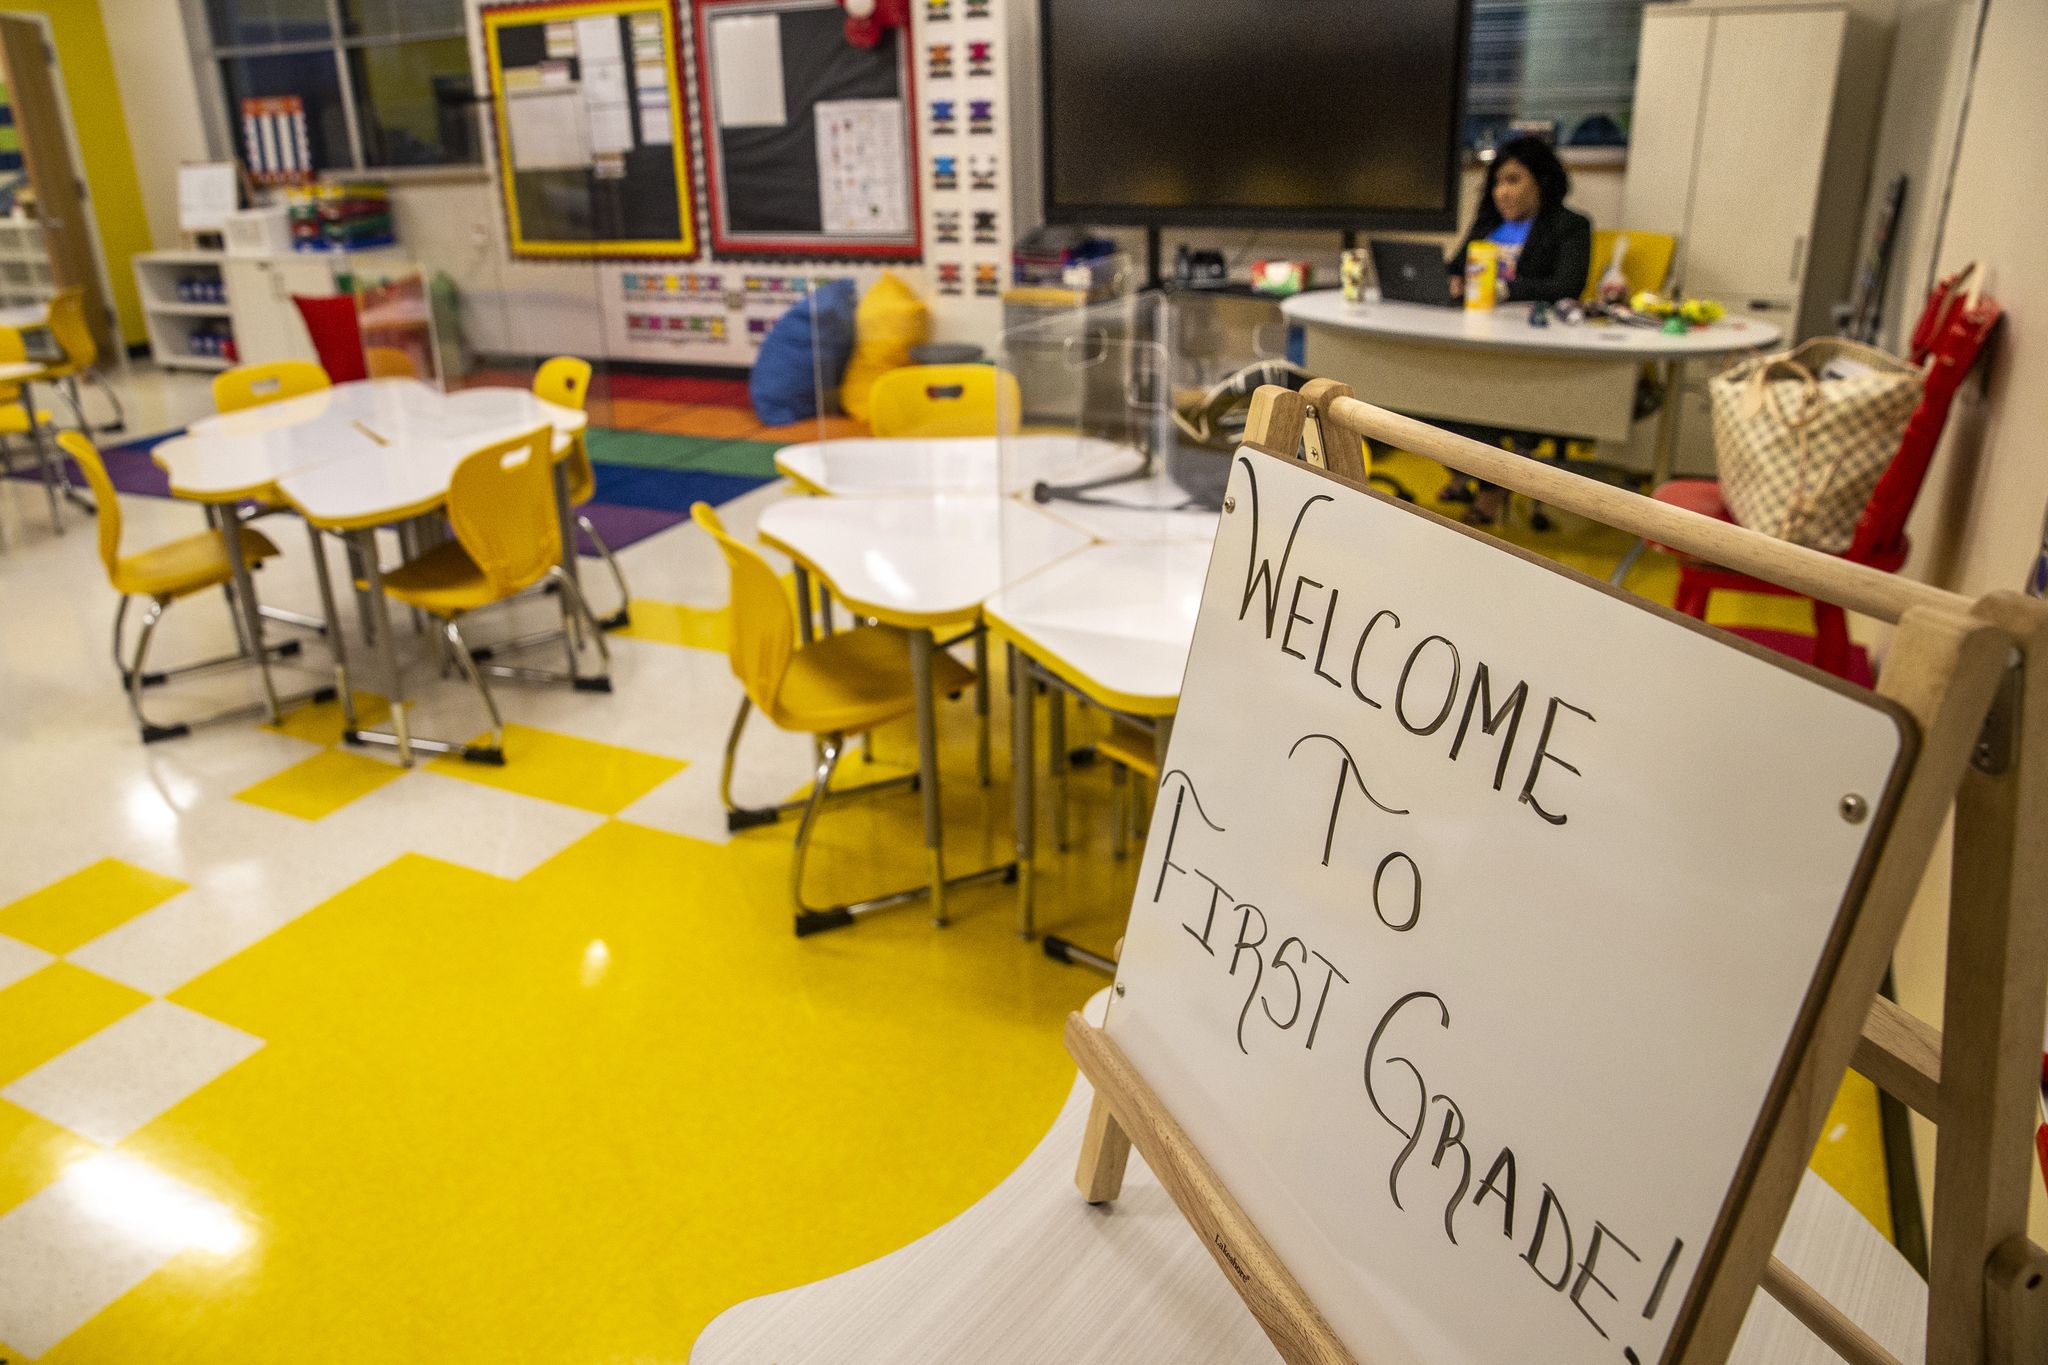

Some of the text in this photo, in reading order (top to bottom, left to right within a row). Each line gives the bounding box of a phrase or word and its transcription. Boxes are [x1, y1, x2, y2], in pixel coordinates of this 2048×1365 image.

[1238, 456, 1597, 825] WELCOME
[1288, 733, 1422, 932] TO
[1153, 769, 1684, 1365] FIRST GRADE!
